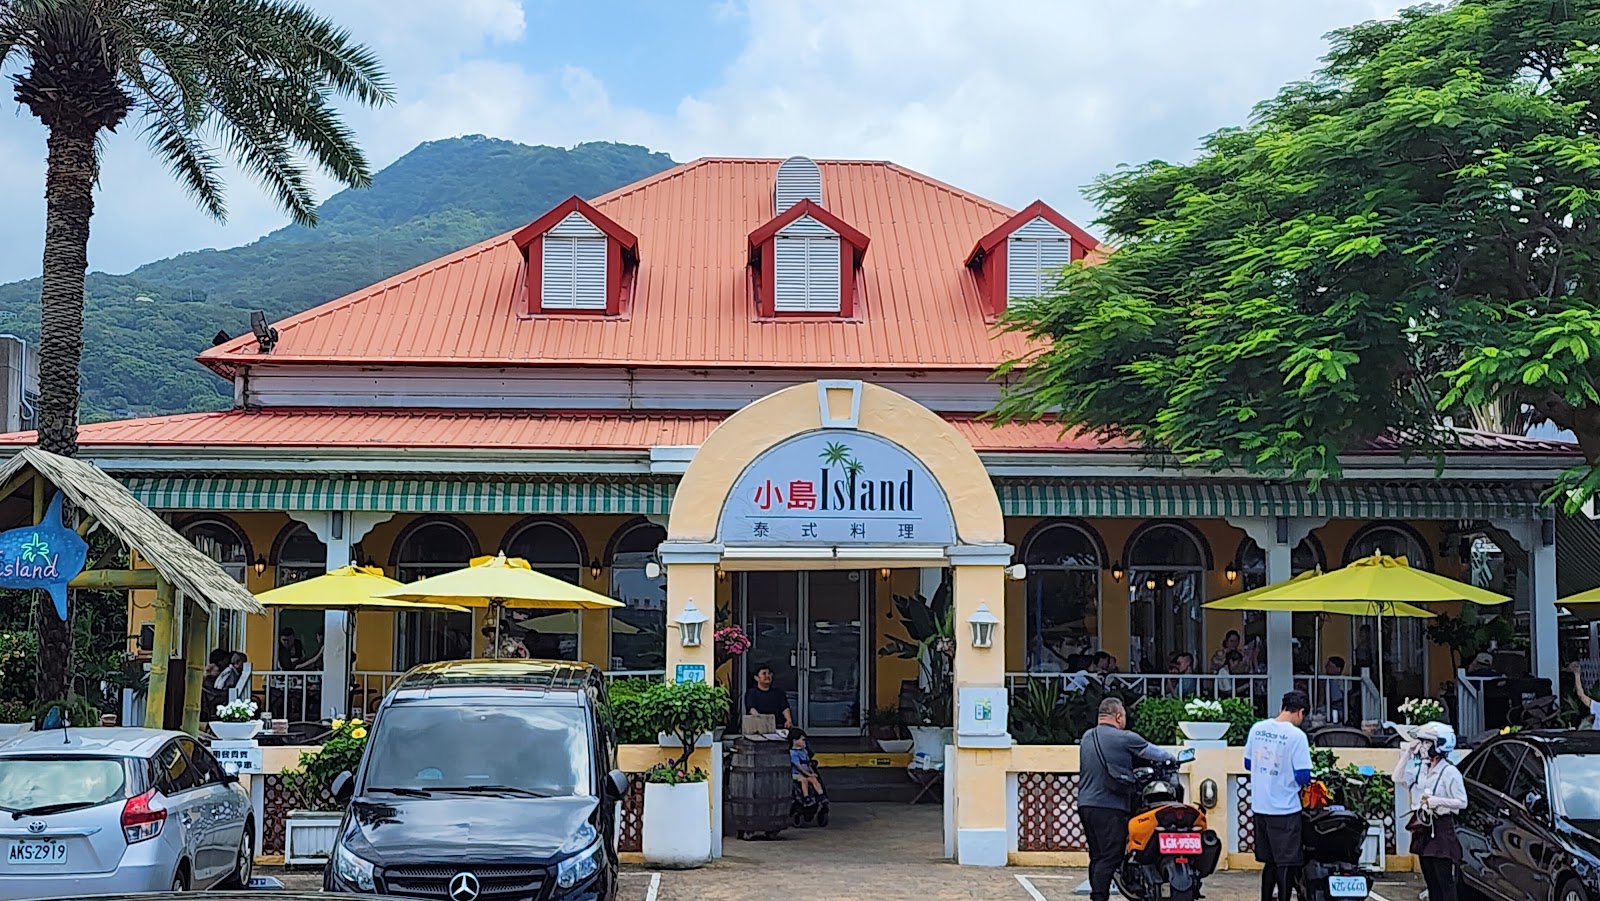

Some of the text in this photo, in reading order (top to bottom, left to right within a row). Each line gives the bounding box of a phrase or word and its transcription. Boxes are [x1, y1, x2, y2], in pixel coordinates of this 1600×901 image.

[753, 467, 915, 512] 小島 Island
[753, 521, 915, 539] 泰式料理
[9, 844, 66, 860] AKS-2919
